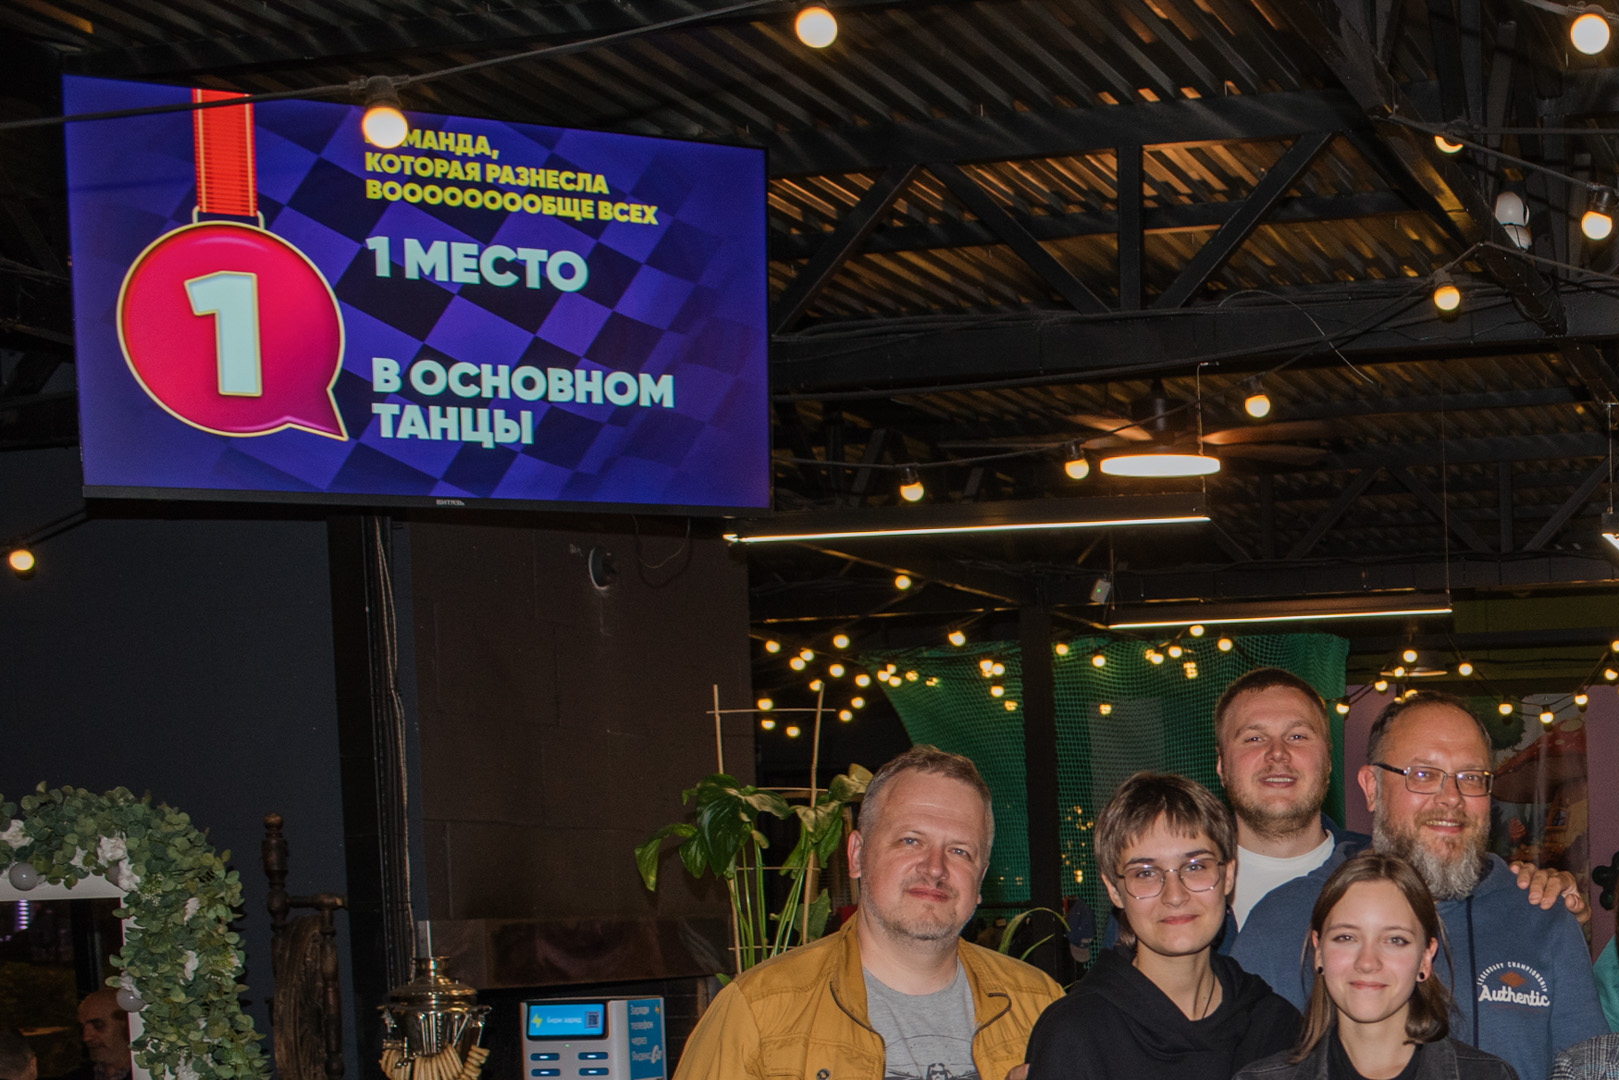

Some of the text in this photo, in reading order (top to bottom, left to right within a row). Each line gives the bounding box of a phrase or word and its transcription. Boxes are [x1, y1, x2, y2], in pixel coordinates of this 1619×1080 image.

[365, 124, 499, 160] МАНДА,
[365, 152, 610, 194] КОТОРАЯ РАЗНЕСЛА
[365, 179, 659, 225] ВООООООООБЩЕ ВСЕХ
[365, 236, 589, 292] 1 МЕСТО
[183, 270, 262, 397] 1
[372, 357, 674, 408] В ОСНОВНОМ
[371, 403, 534, 449] ТАНЦЫ
[1478, 985, 1550, 1007] Authentic
